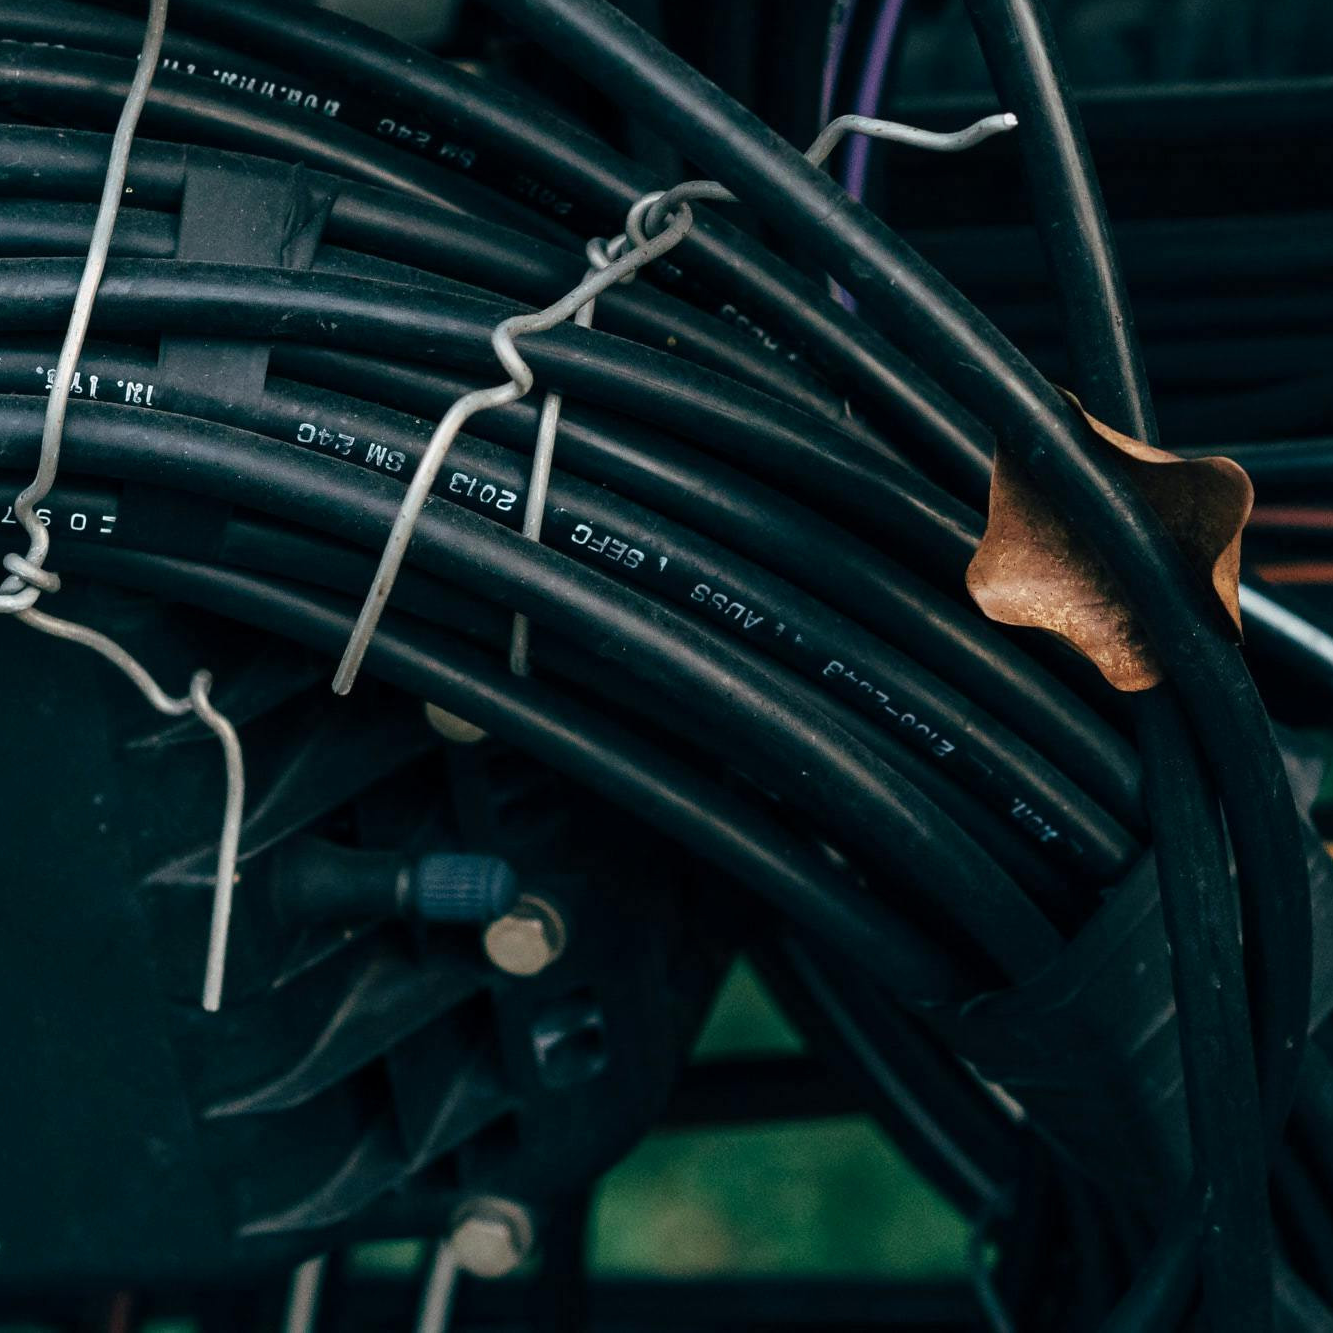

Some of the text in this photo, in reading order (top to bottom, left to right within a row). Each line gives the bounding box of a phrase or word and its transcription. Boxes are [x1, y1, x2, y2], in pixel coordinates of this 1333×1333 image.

[364, 441, 407, 474] SM
[448, 471, 518, 514] 2013
[569, 520, 647, 572] SEFC
